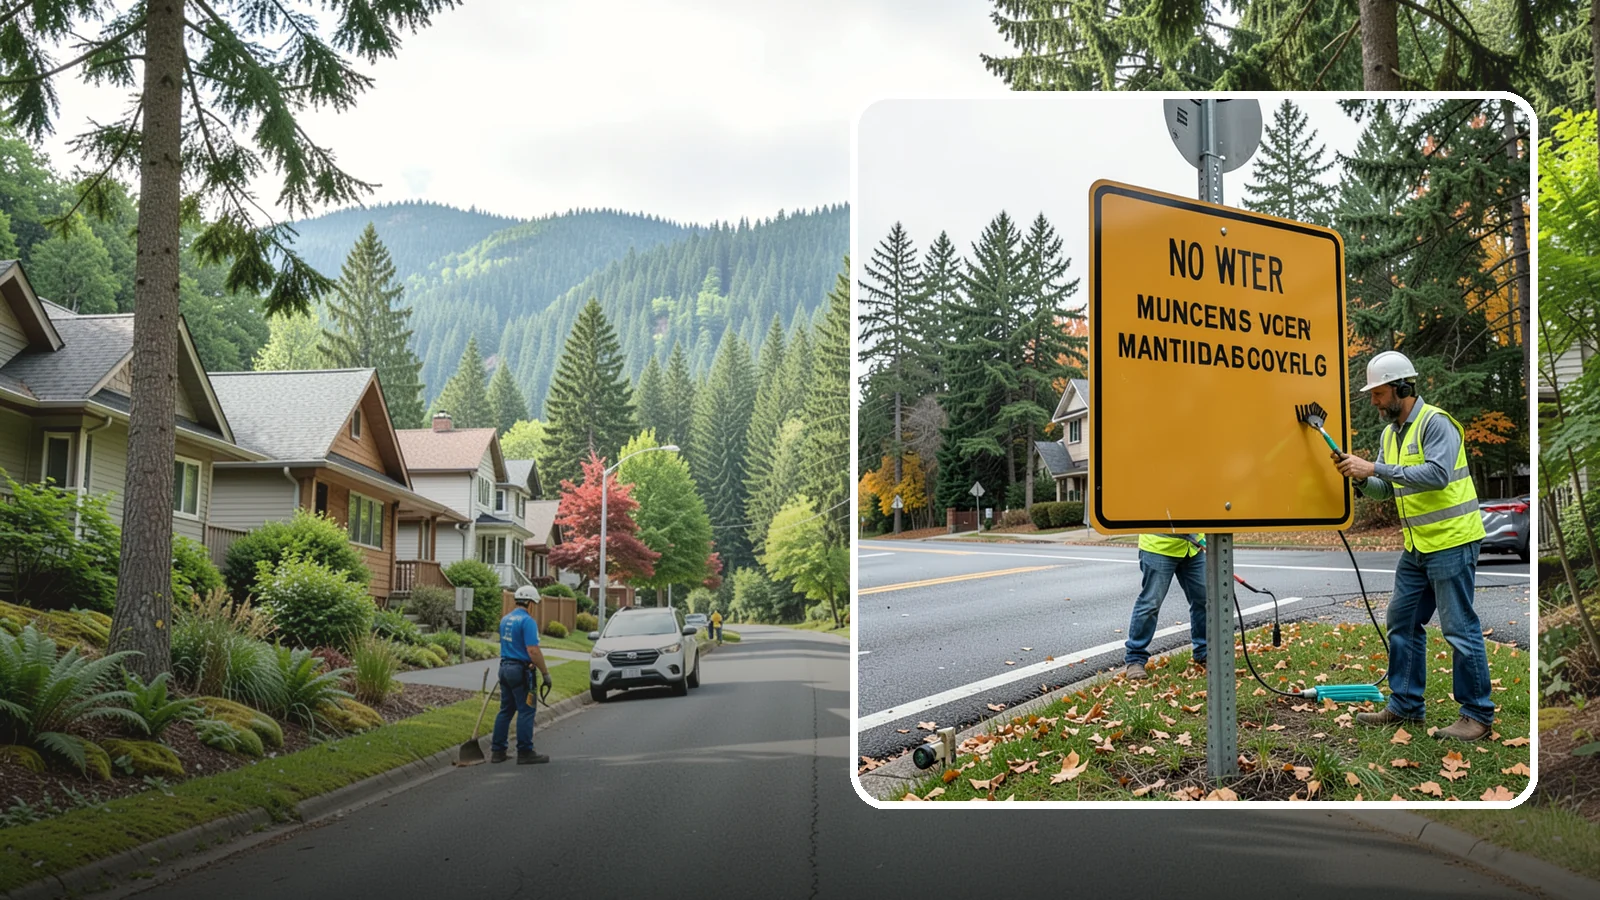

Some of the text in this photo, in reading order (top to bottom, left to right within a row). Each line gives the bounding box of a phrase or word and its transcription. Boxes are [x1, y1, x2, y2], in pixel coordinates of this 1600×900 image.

[1168, 237, 1284, 295] NO WTER
[1136, 293, 1252, 333] MUNCENS
